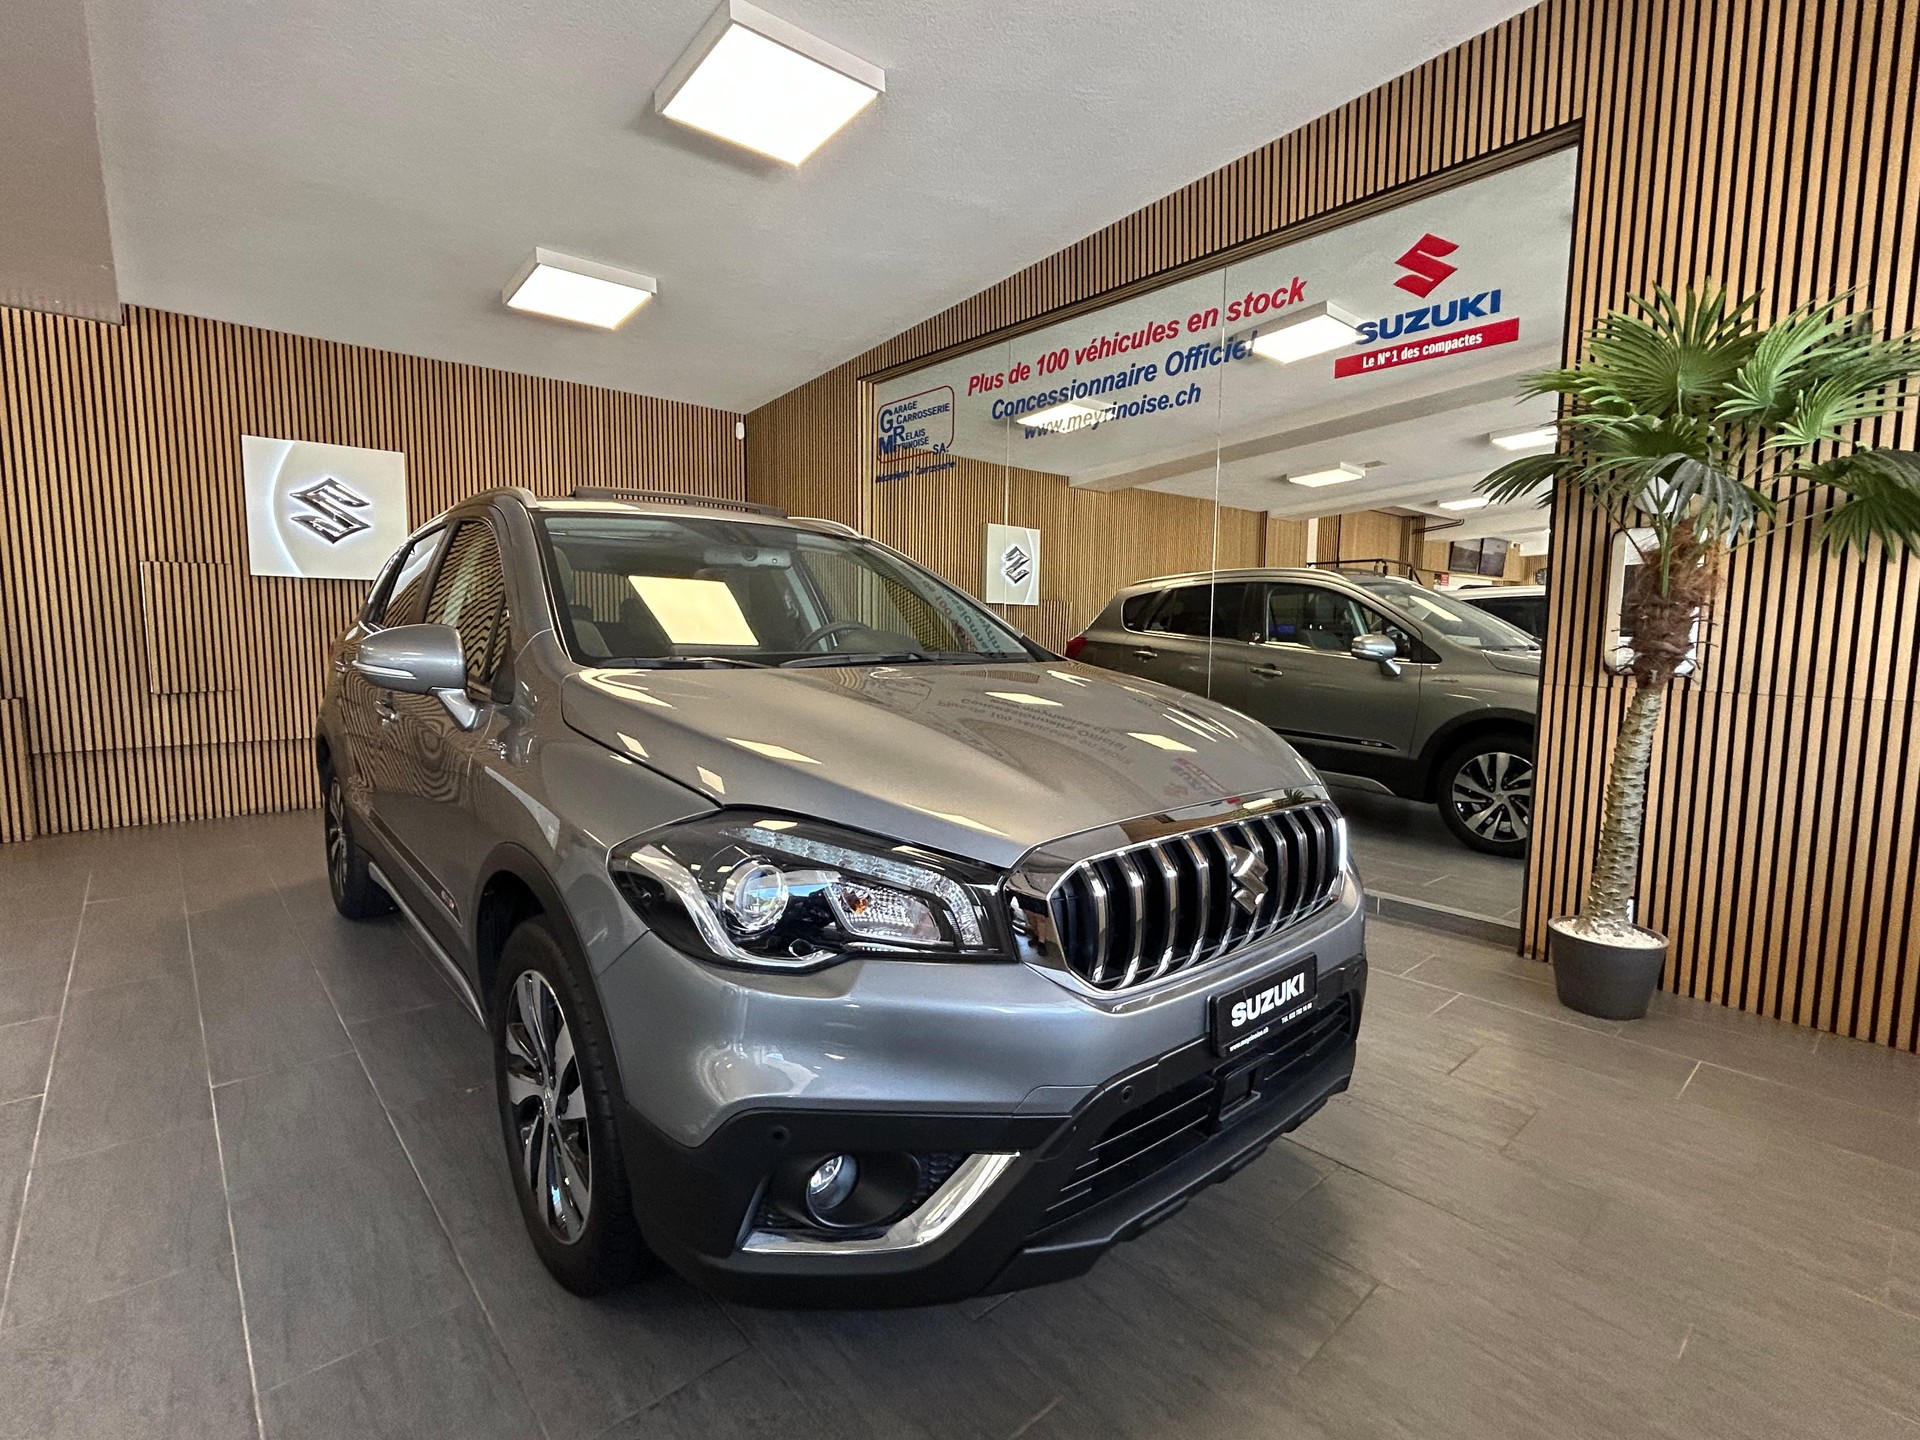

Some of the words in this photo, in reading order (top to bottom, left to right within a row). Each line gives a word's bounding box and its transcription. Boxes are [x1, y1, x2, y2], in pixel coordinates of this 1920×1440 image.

[967, 372, 1004, 396] Plus
[1008, 362, 1031, 384] de
[1036, 348, 1069, 376] 100
[1075, 319, 1180, 366] véhicules
[1187, 307, 1219, 333] en
[1226, 276, 1308, 322] stock
[1355, 289, 1502, 345] SUZUKI
[991, 363, 1158, 420] Concessionnaire
[1164, 330, 1258, 377] Officiel
[1362, 355, 1375, 369] Le
[1401, 346, 1420, 361] des
[1422, 332, 1483, 356] compactes
[880, 401, 918, 433] GARAGE
[896, 402, 950, 425] CARROSSERIE
[1024, 383, 1202, 440] www.meyrinoise.ch
[1231, 972, 1305, 1028] SUZUKI
